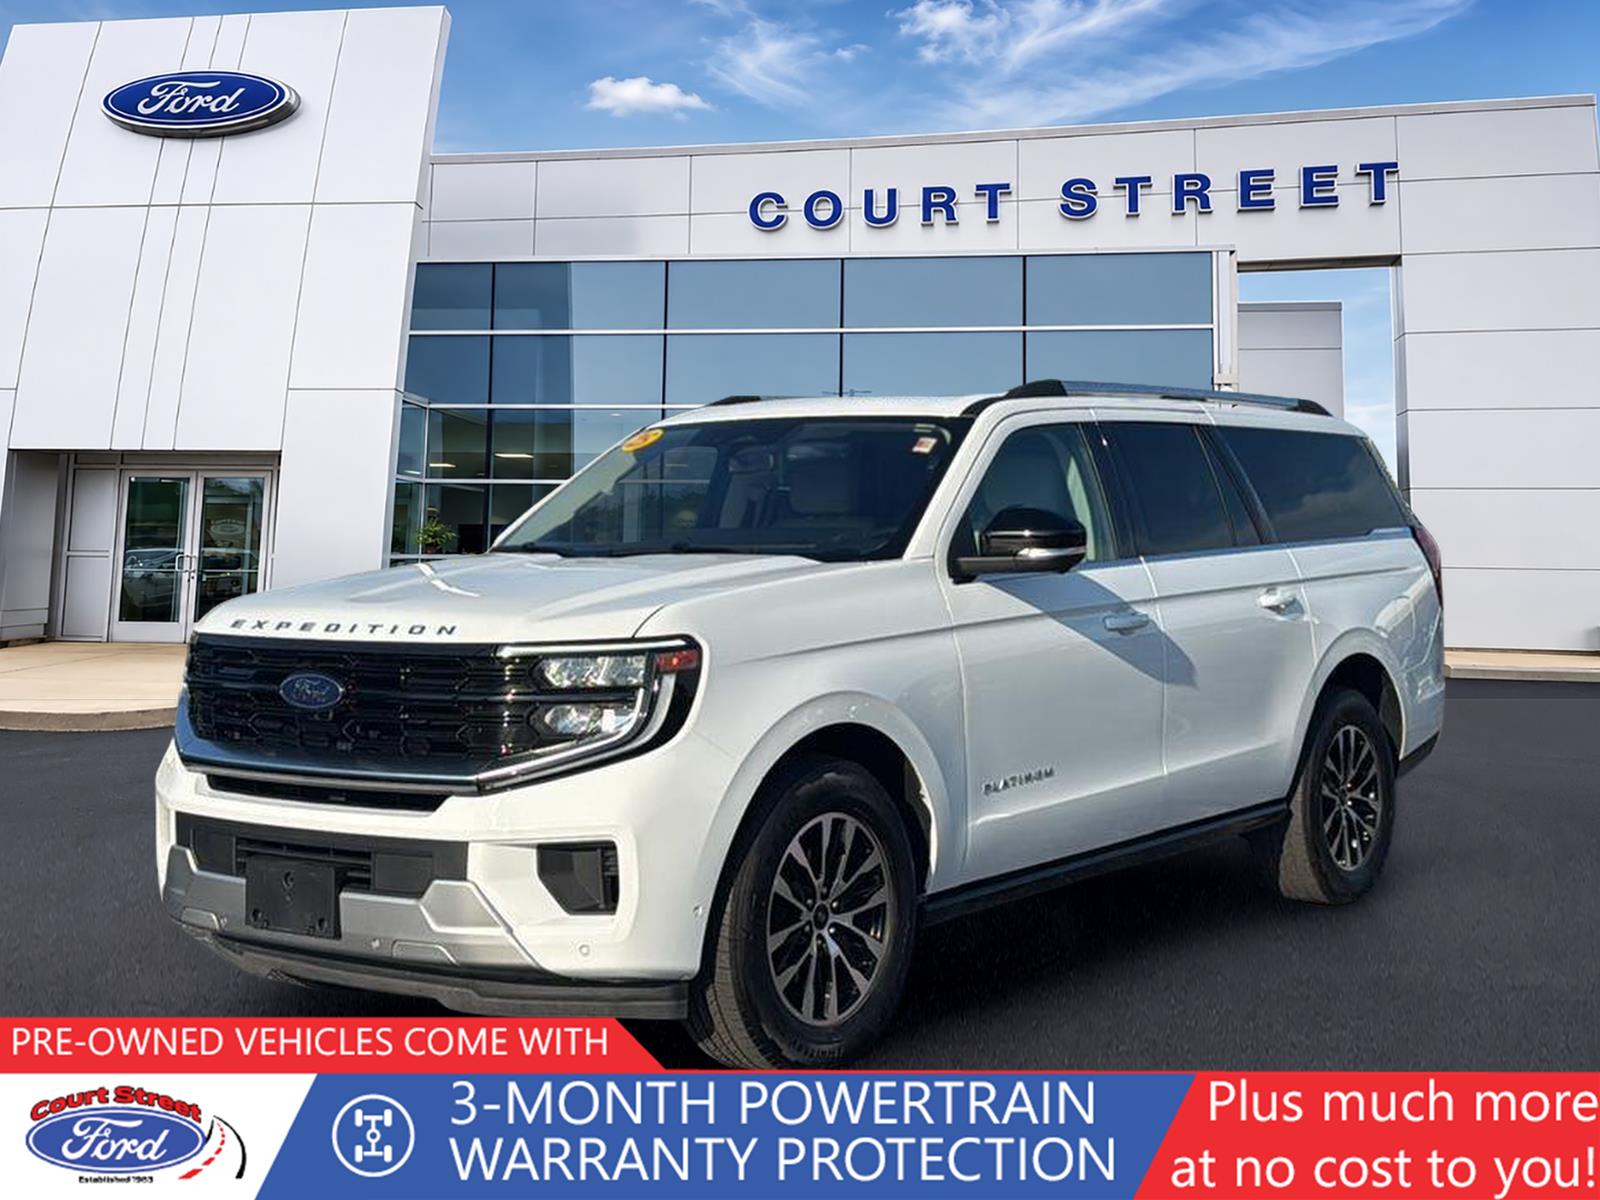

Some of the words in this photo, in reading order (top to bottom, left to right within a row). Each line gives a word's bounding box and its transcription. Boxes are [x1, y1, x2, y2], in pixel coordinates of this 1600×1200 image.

[137, 81, 246, 115] Ford
[748, 181, 1012, 231] COURT
[1058, 161, 1400, 219] STREET
[230, 619, 458, 636] EXPEDITION
[983, 767, 1055, 797] PLATINUM
